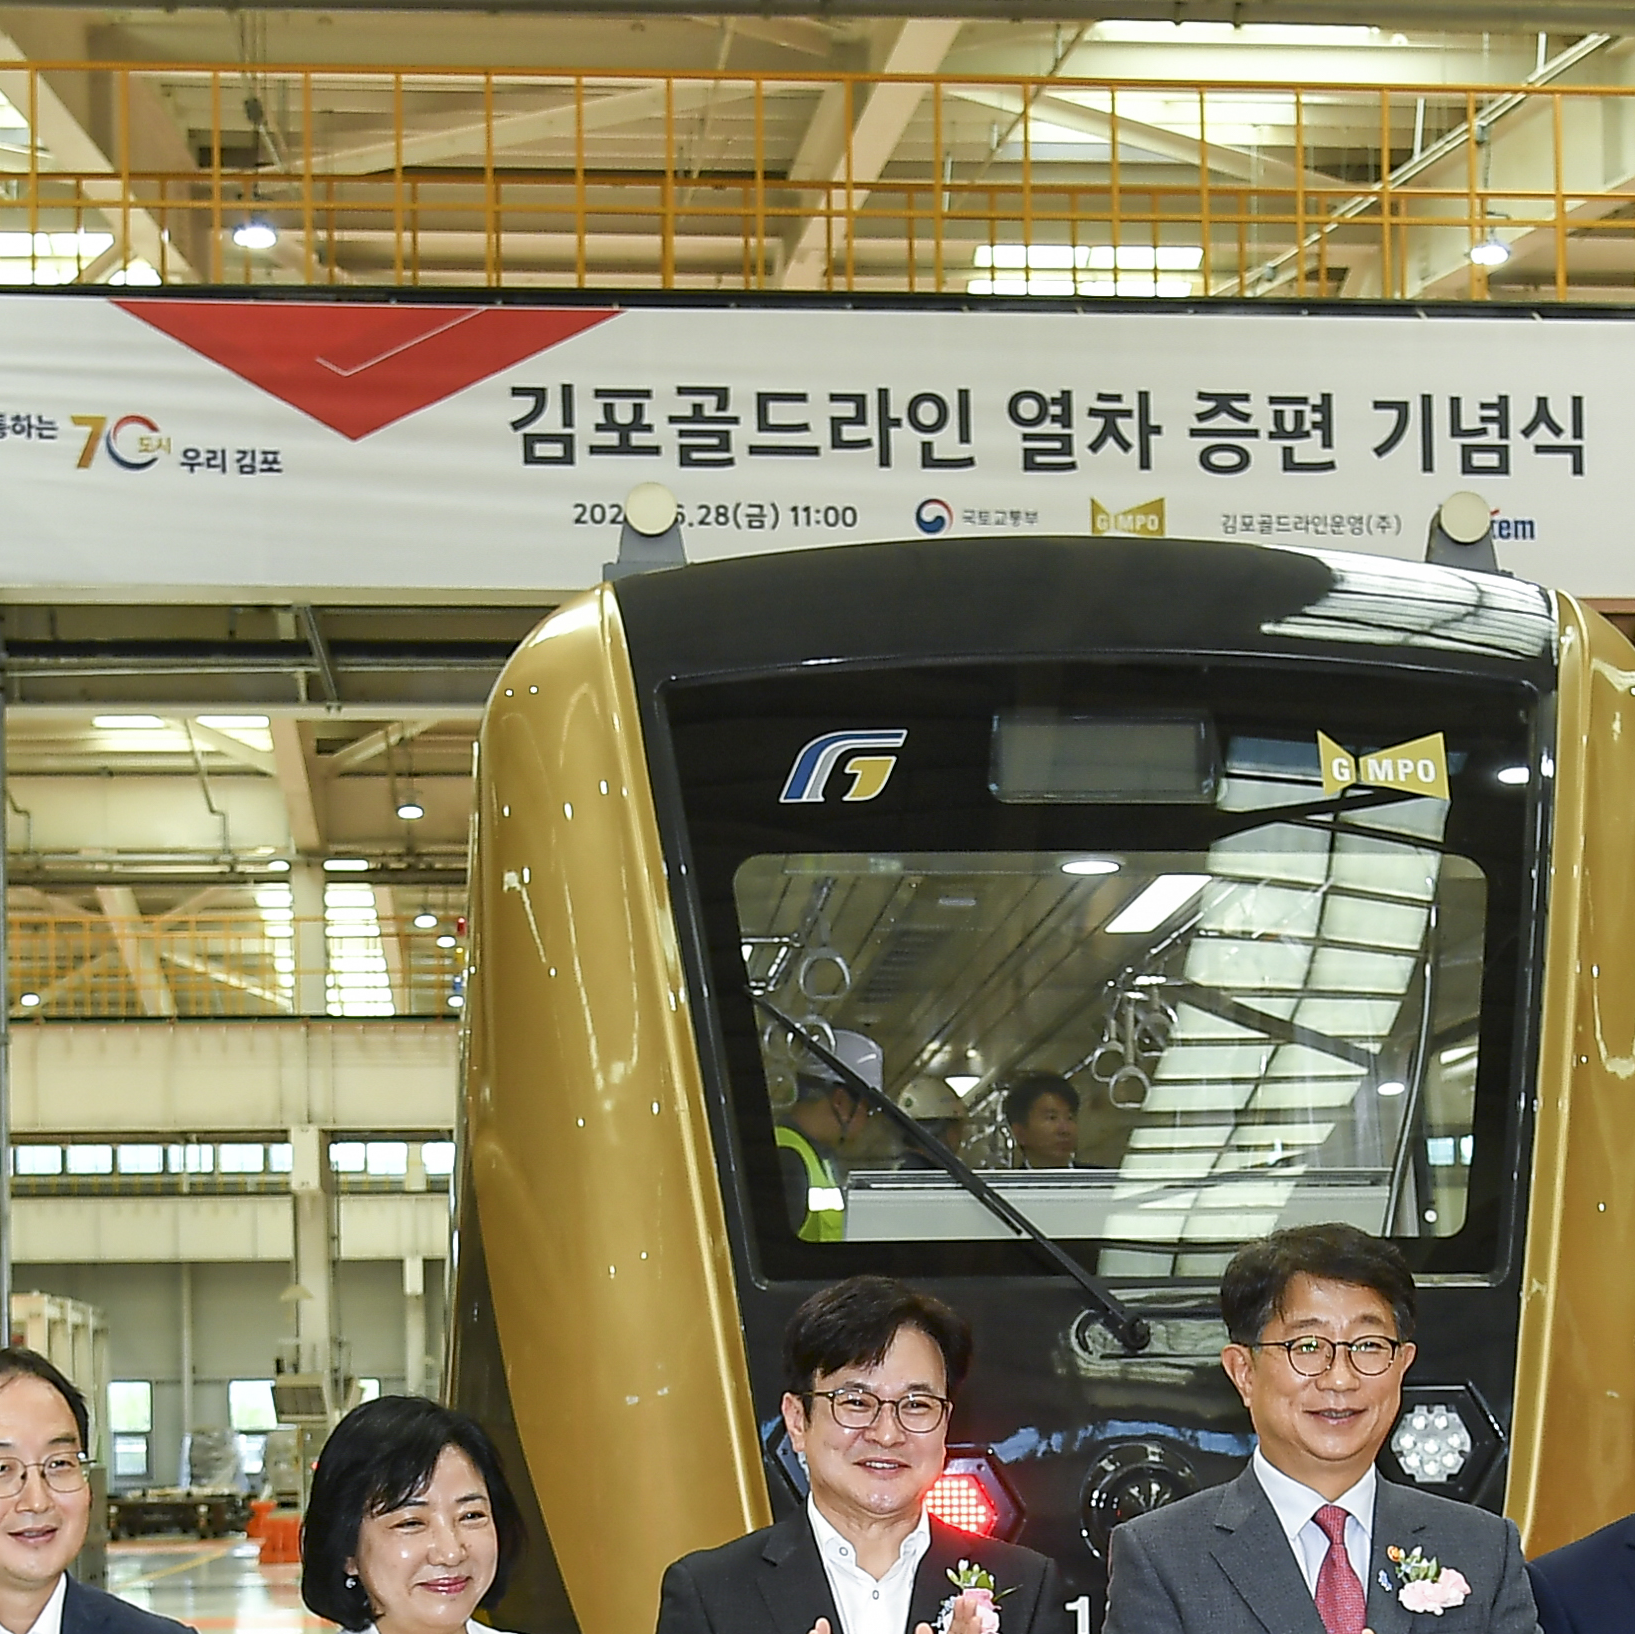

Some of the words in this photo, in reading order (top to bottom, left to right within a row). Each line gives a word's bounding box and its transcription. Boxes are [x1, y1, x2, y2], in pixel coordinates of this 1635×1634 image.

[509, 383, 977, 471] 김포골드라인
[1007, 388, 1163, 473] 열차
[1188, 390, 1337, 475] 증편
[1372, 392, 1585, 477] 기념식
[179, 446, 227, 475] 우리
[235, 448, 283, 475] 김포
[790, 505, 858, 528] 11:00
[962, 508, 1039, 527] 국토교통부
[1221, 513, 1403, 536] 김포골드라인운영(주)
